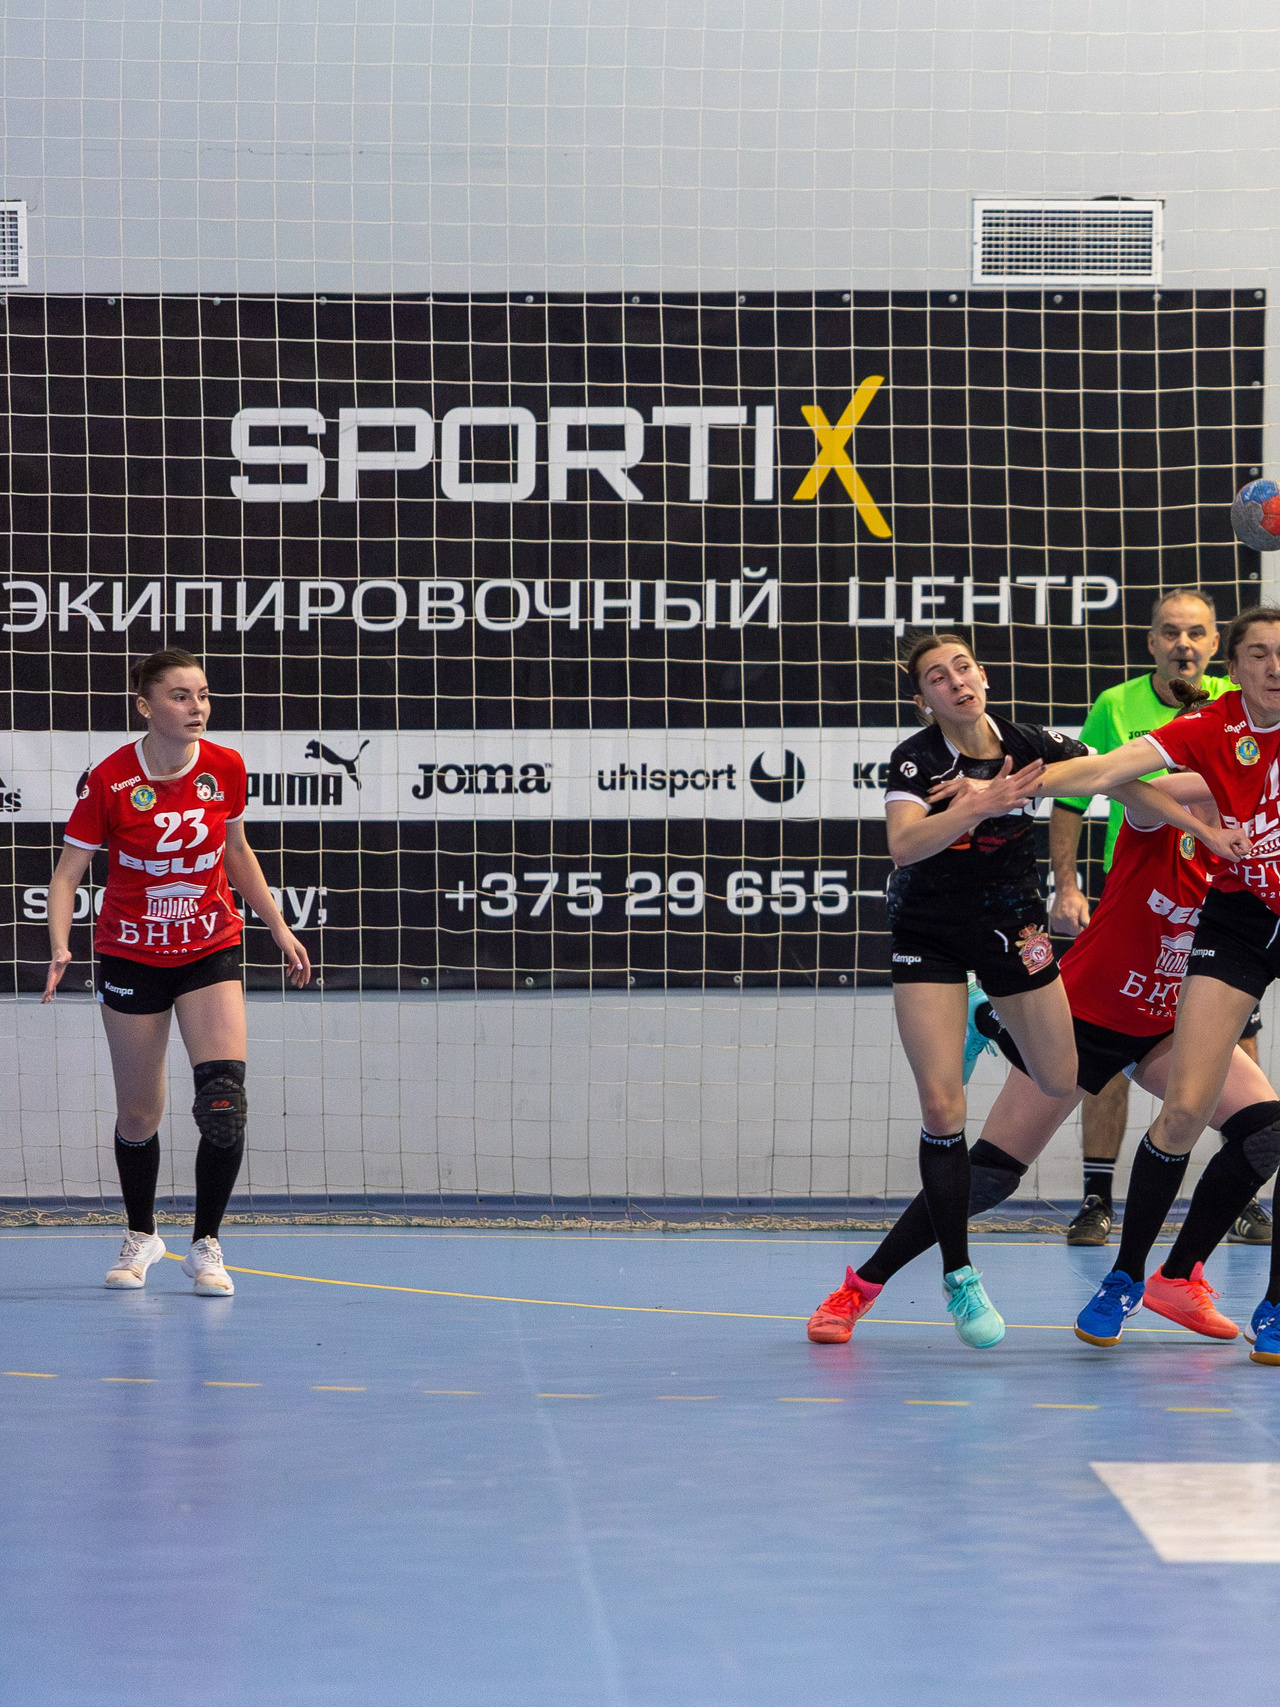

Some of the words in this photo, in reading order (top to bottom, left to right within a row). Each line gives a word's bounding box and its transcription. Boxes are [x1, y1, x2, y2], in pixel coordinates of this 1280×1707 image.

[230, 375, 893, 538] SPORTIX
[1, 567, 780, 633] ЭКИПИРОВОЧНЫЙ
[848, 575, 1119, 637] ЦЕНТР
[110, 775, 142, 793] Kempa
[597, 763, 737, 798] uhlsport
[153, 808, 209, 853] 23
[445, 872, 603, 918] +375
[624, 871, 704, 917] 29
[117, 911, 219, 946] БНТУ
[892, 952, 922, 965] Kempa
[104, 981, 134, 997] Kempa
[1118, 969, 1181, 1008] БНТ
